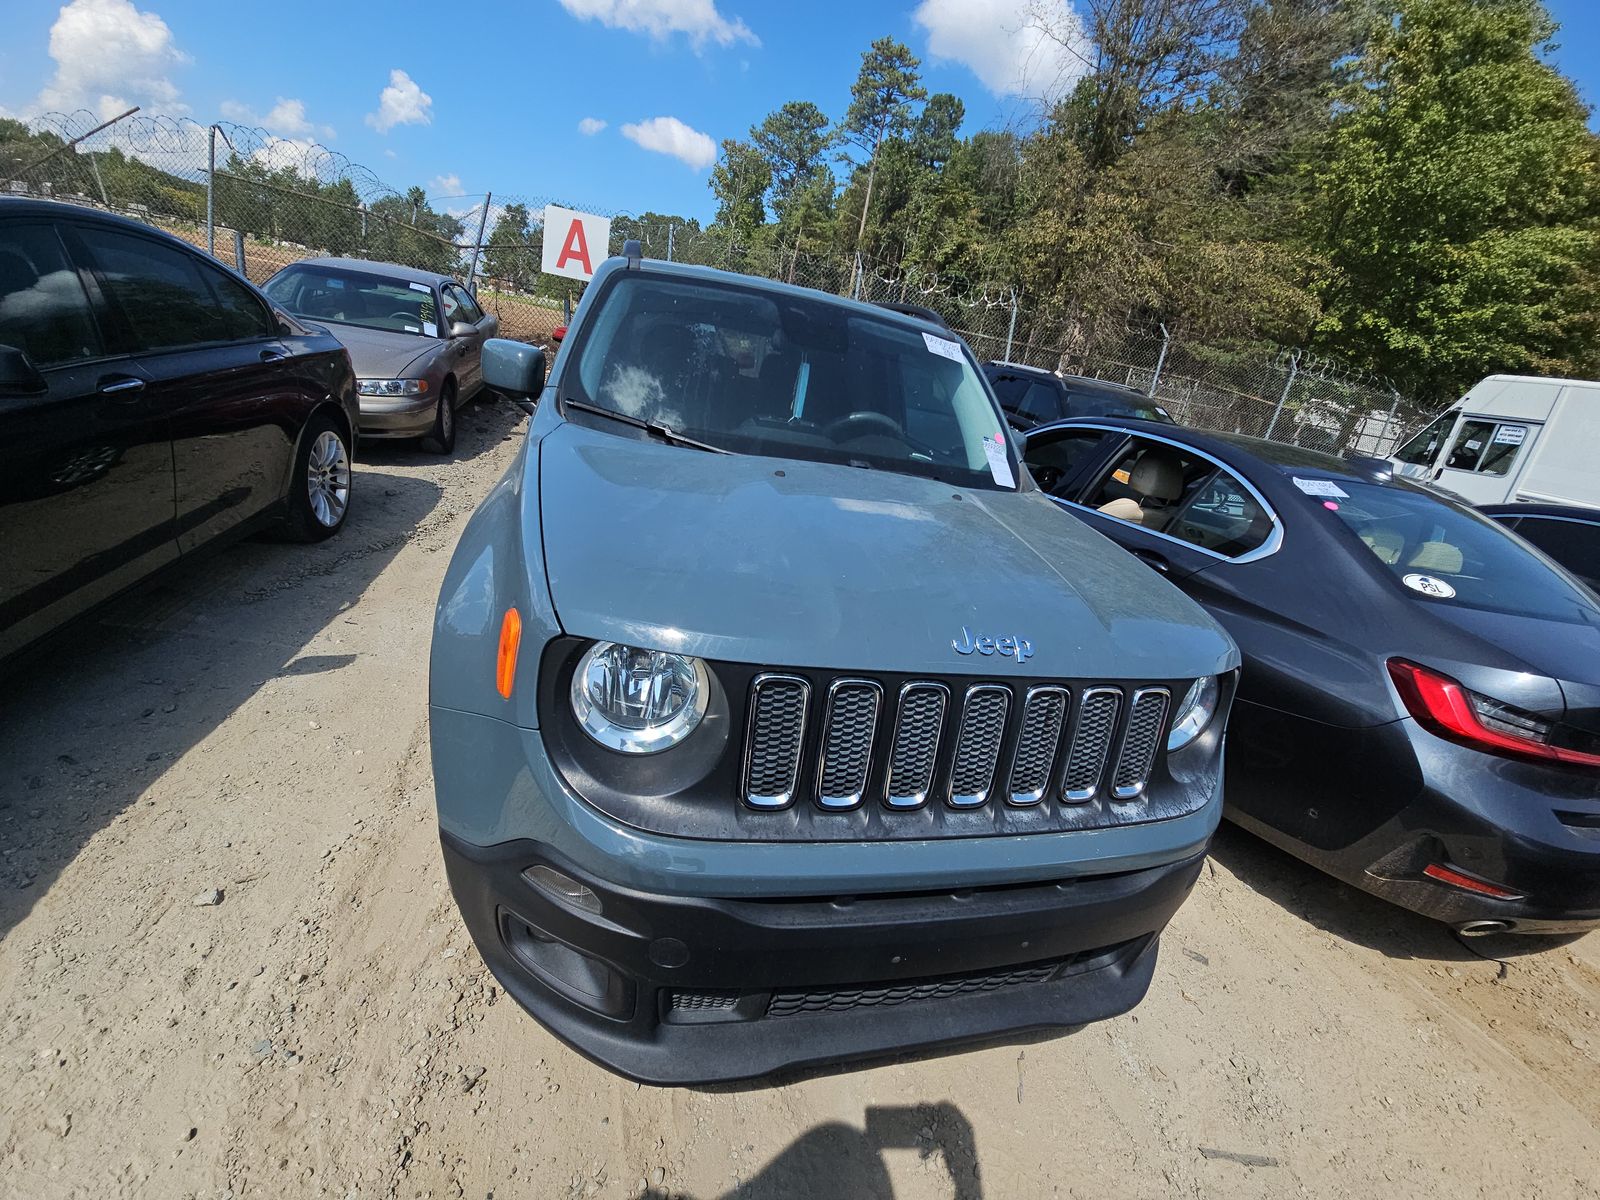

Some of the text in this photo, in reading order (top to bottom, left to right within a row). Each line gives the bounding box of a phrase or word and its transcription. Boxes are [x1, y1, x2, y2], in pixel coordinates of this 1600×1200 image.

[556, 219, 593, 275] A
[1420, 582, 1444, 594] PSL
[950, 625, 1036, 663] Jeep
